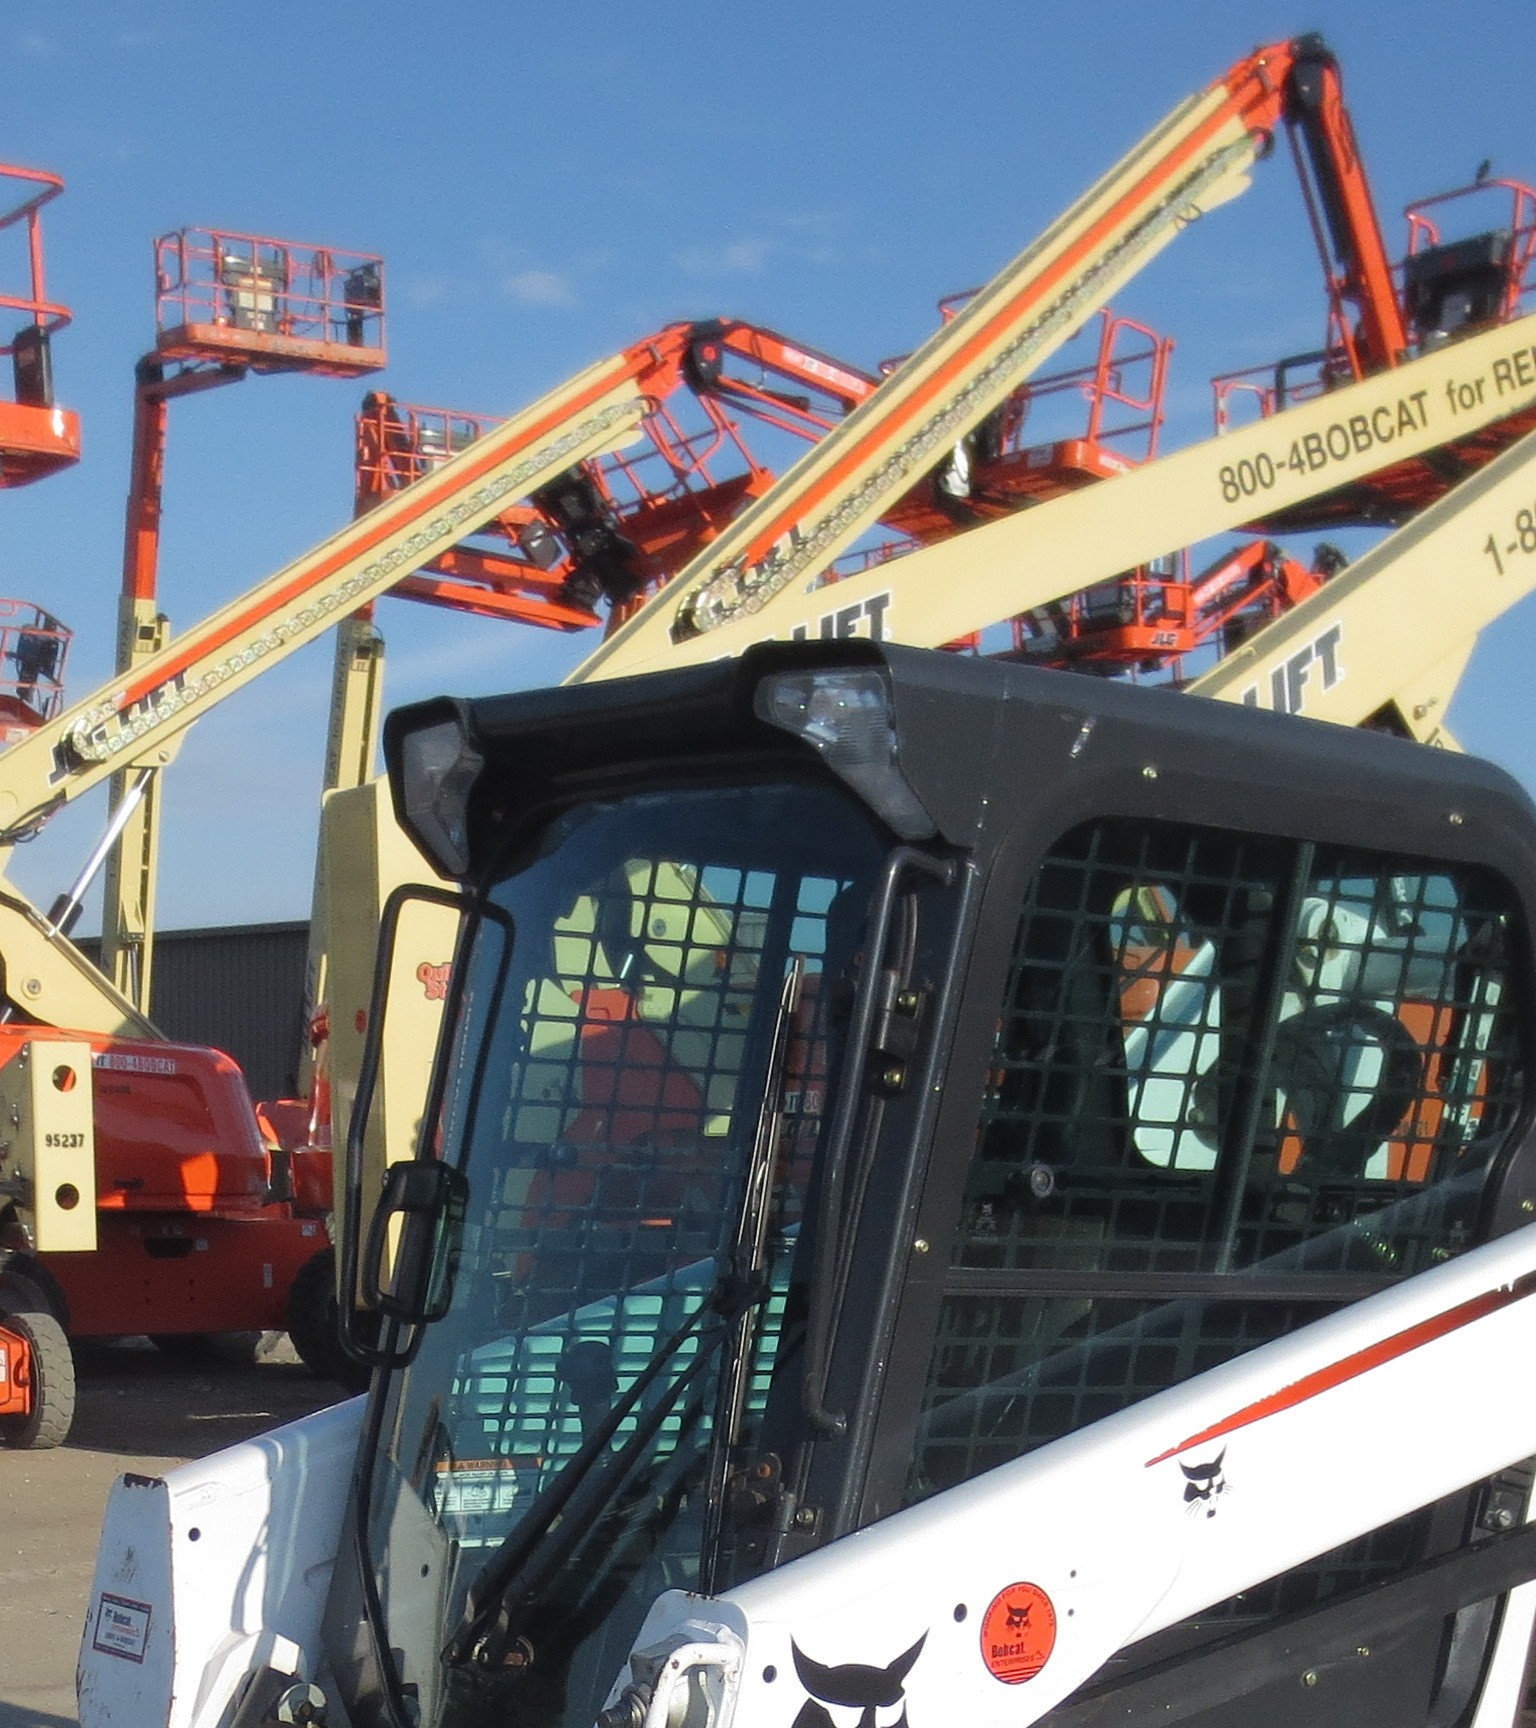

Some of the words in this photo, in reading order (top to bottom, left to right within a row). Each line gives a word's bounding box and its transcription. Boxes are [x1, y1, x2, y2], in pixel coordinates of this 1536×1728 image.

[1219, 390, 1430, 503] 800-4BOBCAT
[1446, 376, 1486, 416] for
[45, 1134, 84, 1147] 95237
[991, 1641, 1024, 1659] Bobcat
